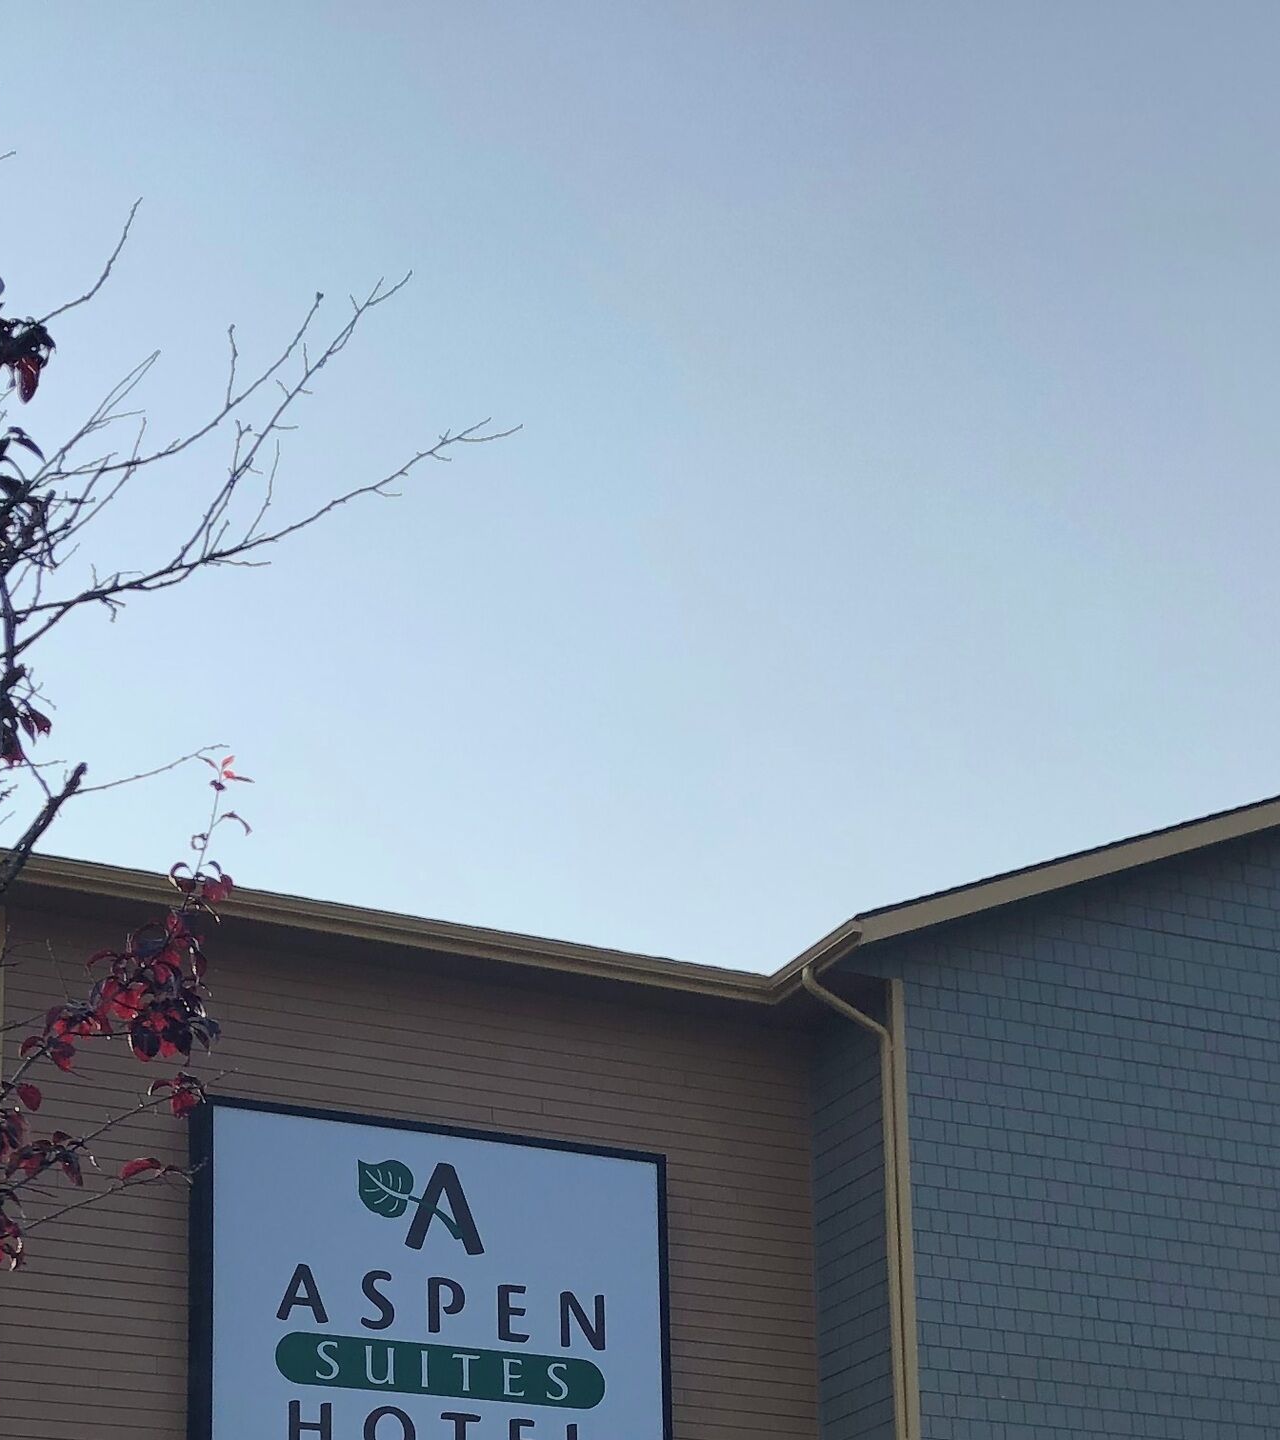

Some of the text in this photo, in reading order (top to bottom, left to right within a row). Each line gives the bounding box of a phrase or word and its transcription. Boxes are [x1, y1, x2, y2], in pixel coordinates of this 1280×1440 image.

[404, 1162, 485, 1255] A
[276, 1263, 607, 1351] ASPEN
[315, 1339, 570, 1401] SUITES
